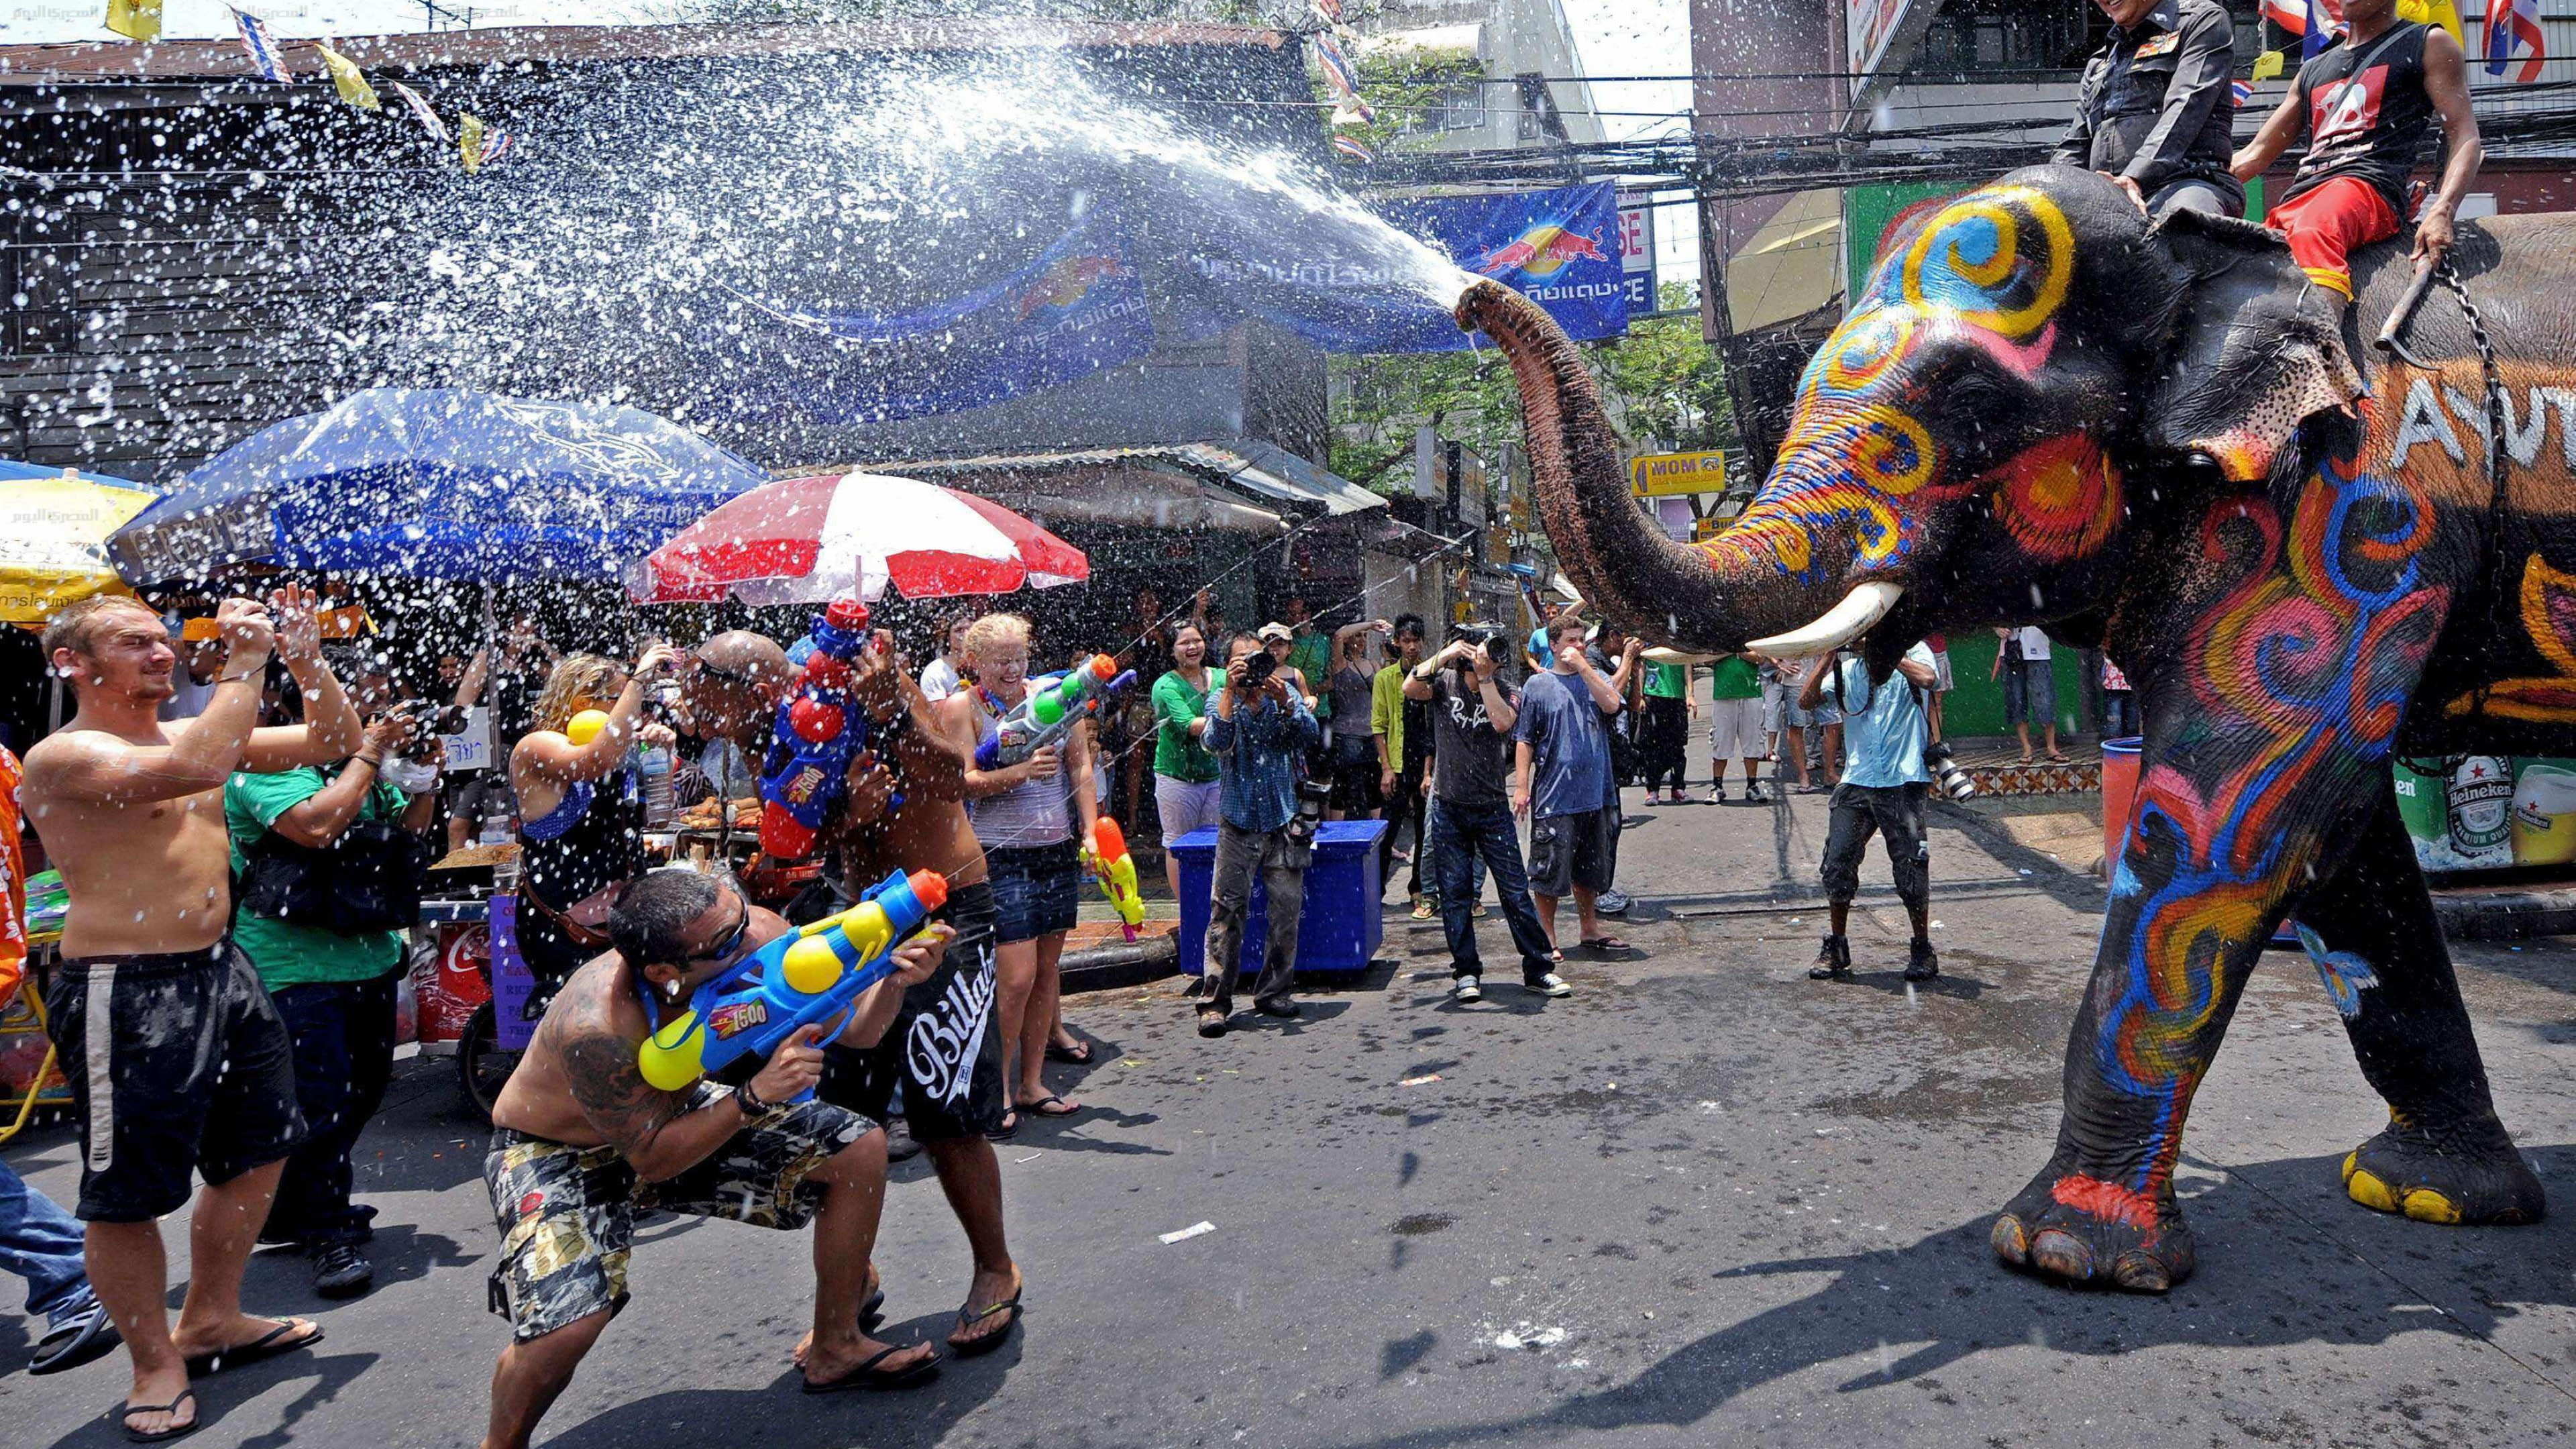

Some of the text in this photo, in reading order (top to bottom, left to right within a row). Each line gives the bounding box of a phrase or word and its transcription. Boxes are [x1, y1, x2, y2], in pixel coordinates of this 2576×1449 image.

[1652, 458, 1697, 476] MOM
[1450, 696, 1490, 729] Ray-Ba
[2450, 784, 2512, 805] Heineken
[733, 1004, 767, 1032] 1500
